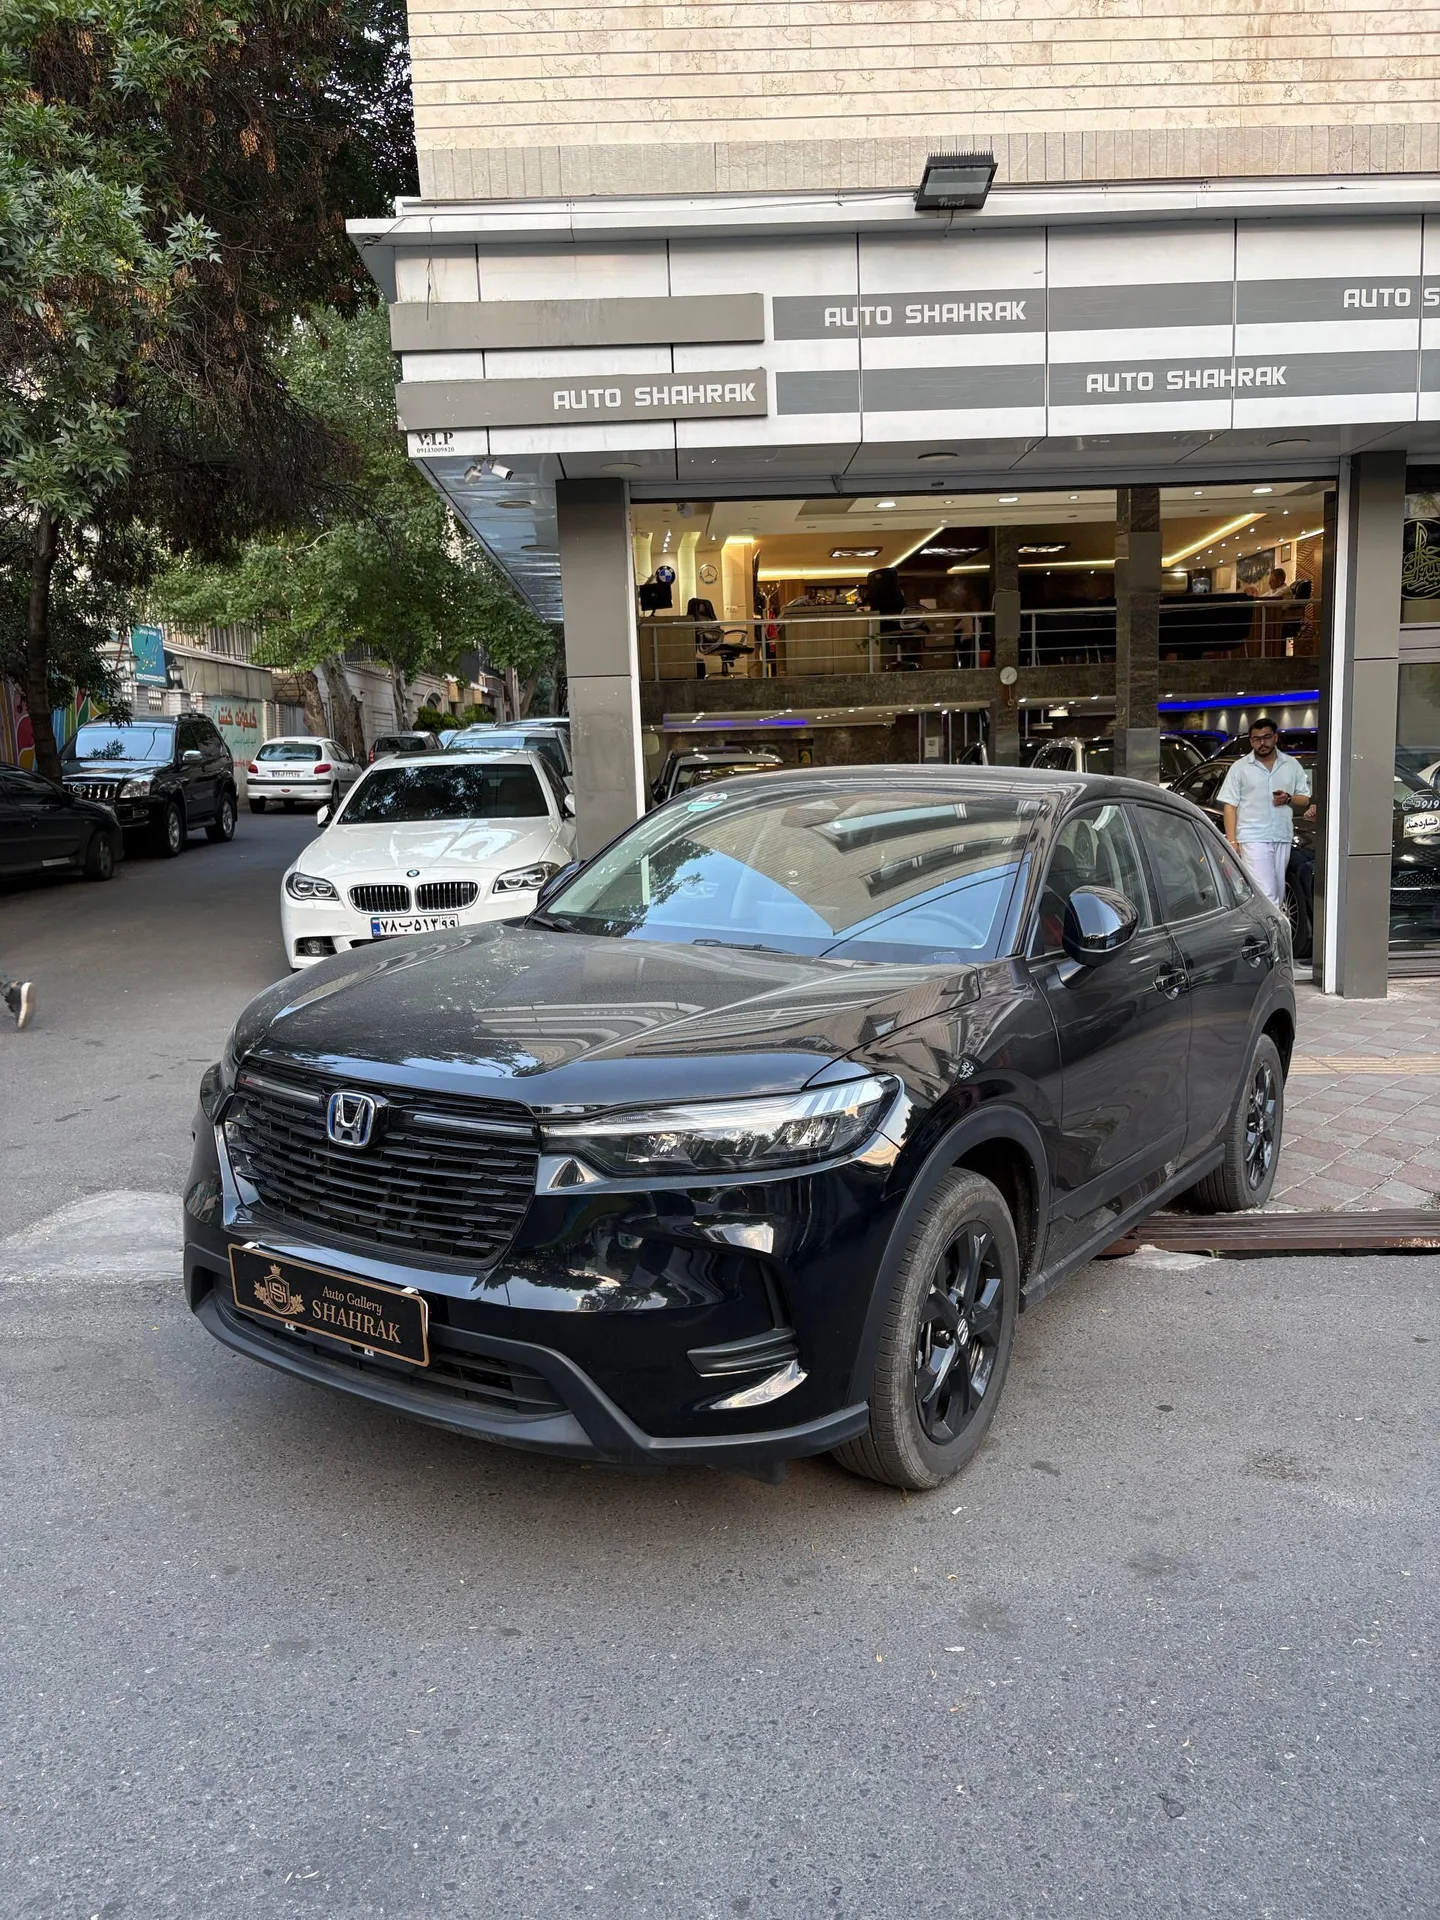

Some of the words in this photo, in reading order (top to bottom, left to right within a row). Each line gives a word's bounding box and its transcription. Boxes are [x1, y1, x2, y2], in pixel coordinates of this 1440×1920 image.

[1343, 287, 1411, 308] AUTO
[824, 305, 893, 327] AUTO
[905, 300, 1027, 324] SHAHRAK
[1086, 371, 1154, 393] AUTO
[1166, 365, 1287, 390] SHAHRAK
[553, 388, 622, 410] AUTO
[634, 382, 757, 407] SHAHRAK
[322, 1285, 345, 1302] Auto
[346, 1292, 383, 1315] Gallery
[311, 1299, 402, 1344] SHAHRAK
